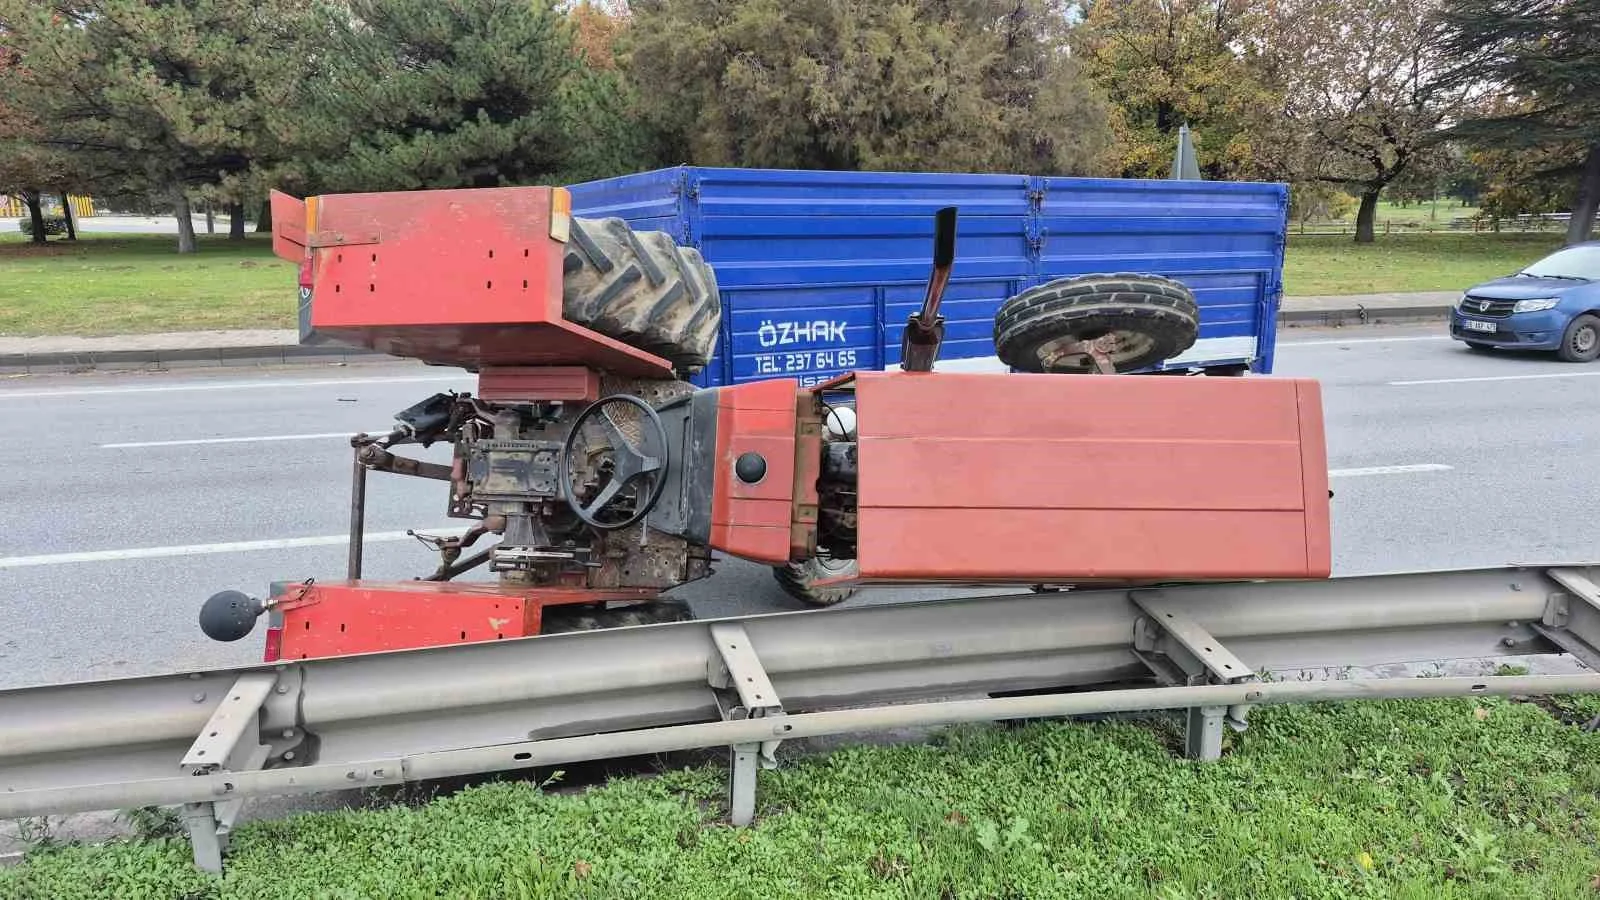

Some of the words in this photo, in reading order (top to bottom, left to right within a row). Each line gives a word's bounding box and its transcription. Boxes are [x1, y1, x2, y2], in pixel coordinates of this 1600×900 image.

[758, 319, 848, 347] ÖZHAK
[786, 353, 812, 372] 237
[816, 352, 834, 369] 64
[838, 350, 857, 367] 65
